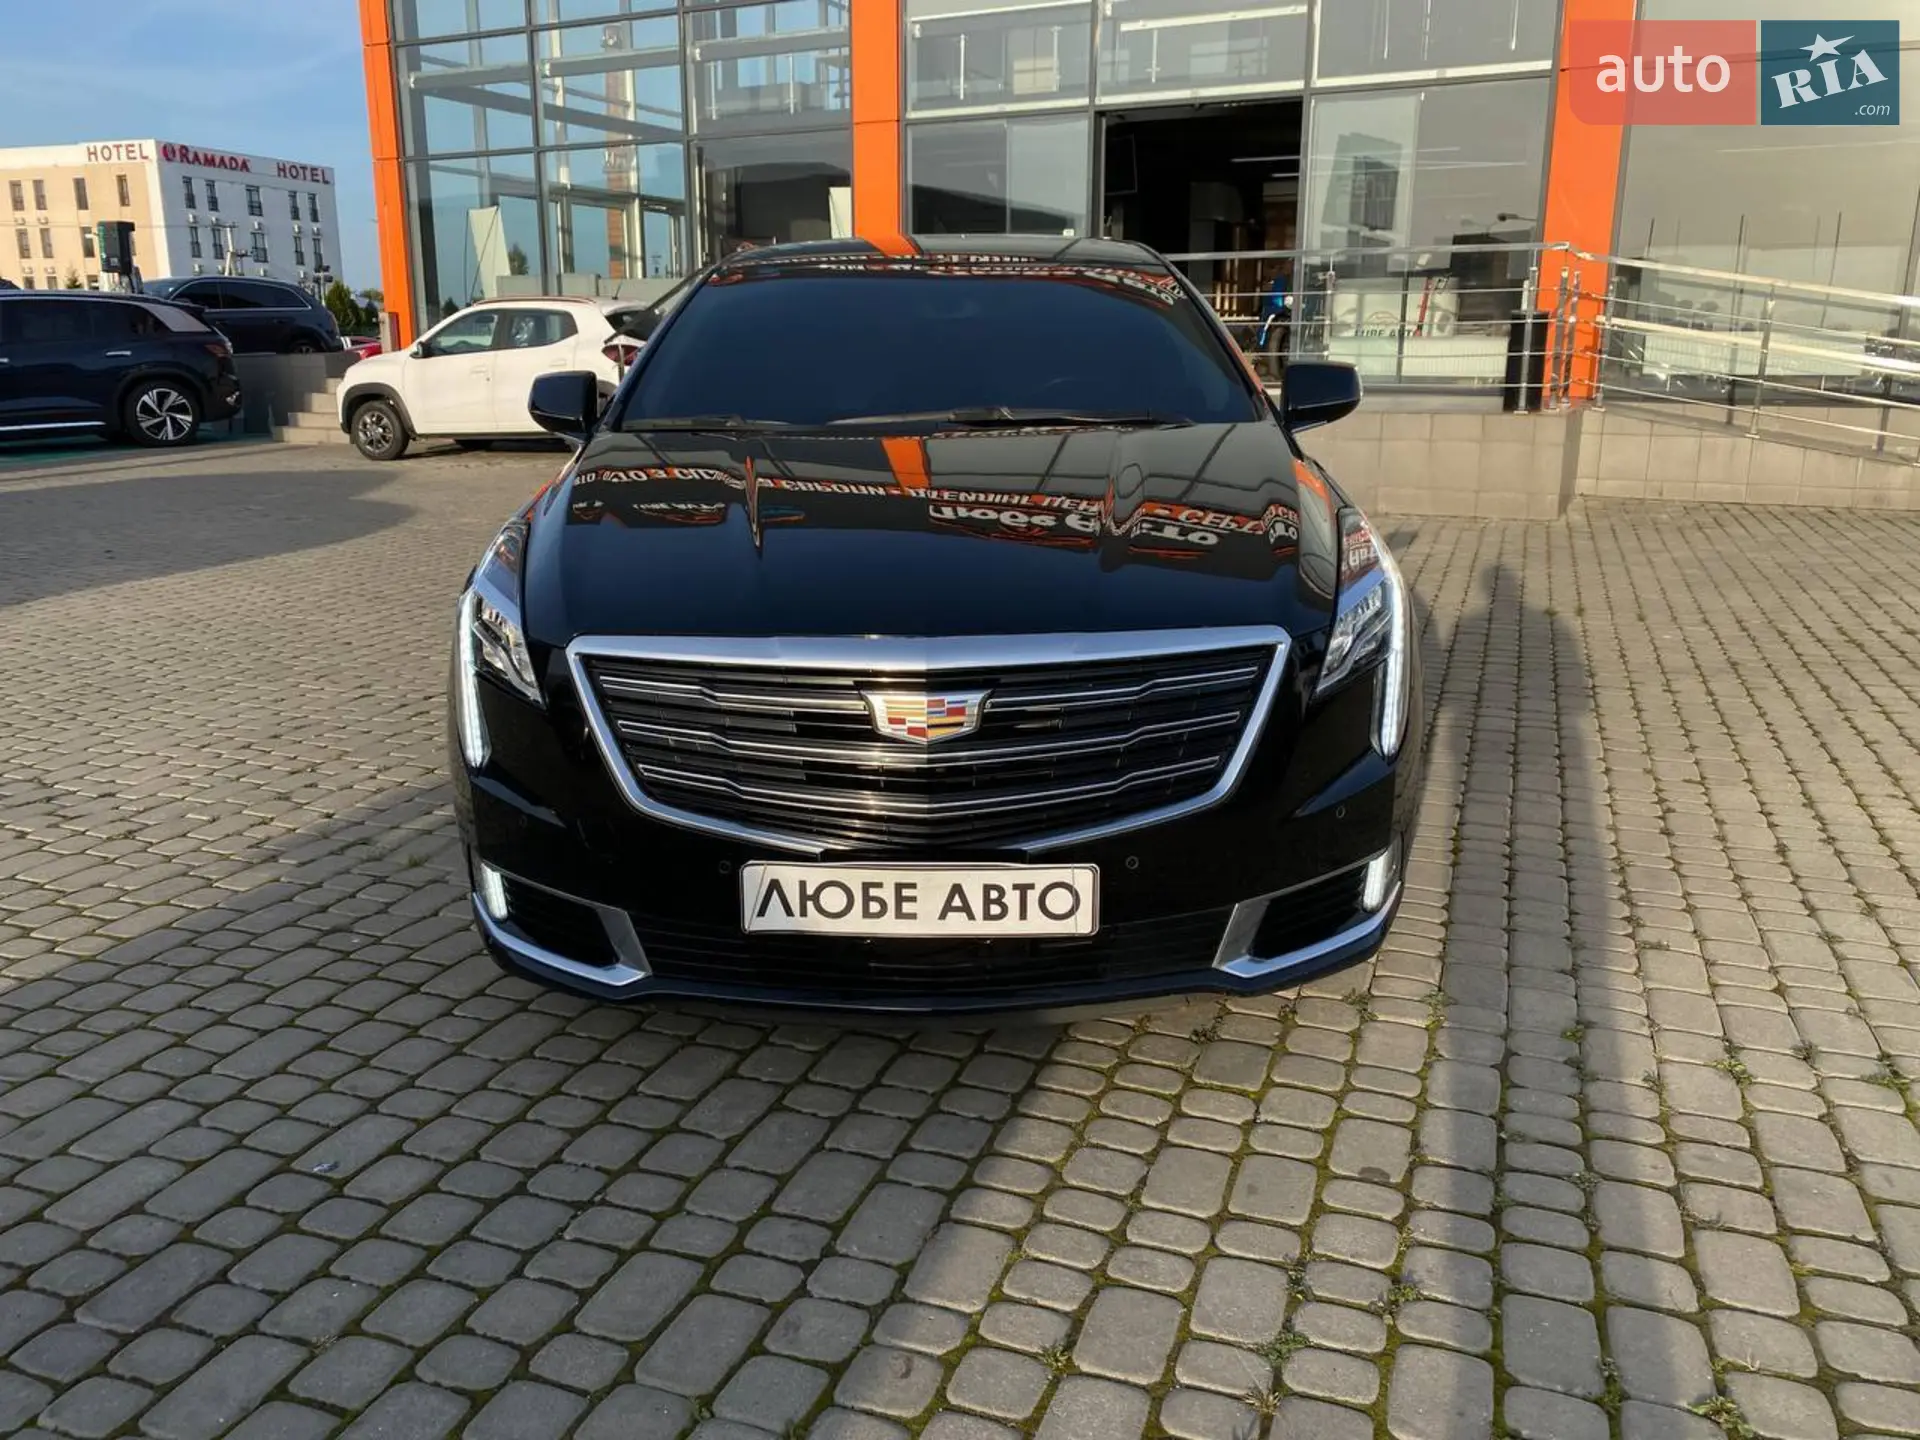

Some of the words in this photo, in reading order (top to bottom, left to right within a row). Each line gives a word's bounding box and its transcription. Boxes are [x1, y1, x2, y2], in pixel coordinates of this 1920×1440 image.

[87, 143, 149, 162] HOTEL
[178, 144, 252, 173] RAMADA
[276, 162, 332, 185] HOTEL
[756, 878, 918, 919] ЛЮБЕ
[938, 881, 1082, 922] АВТО
